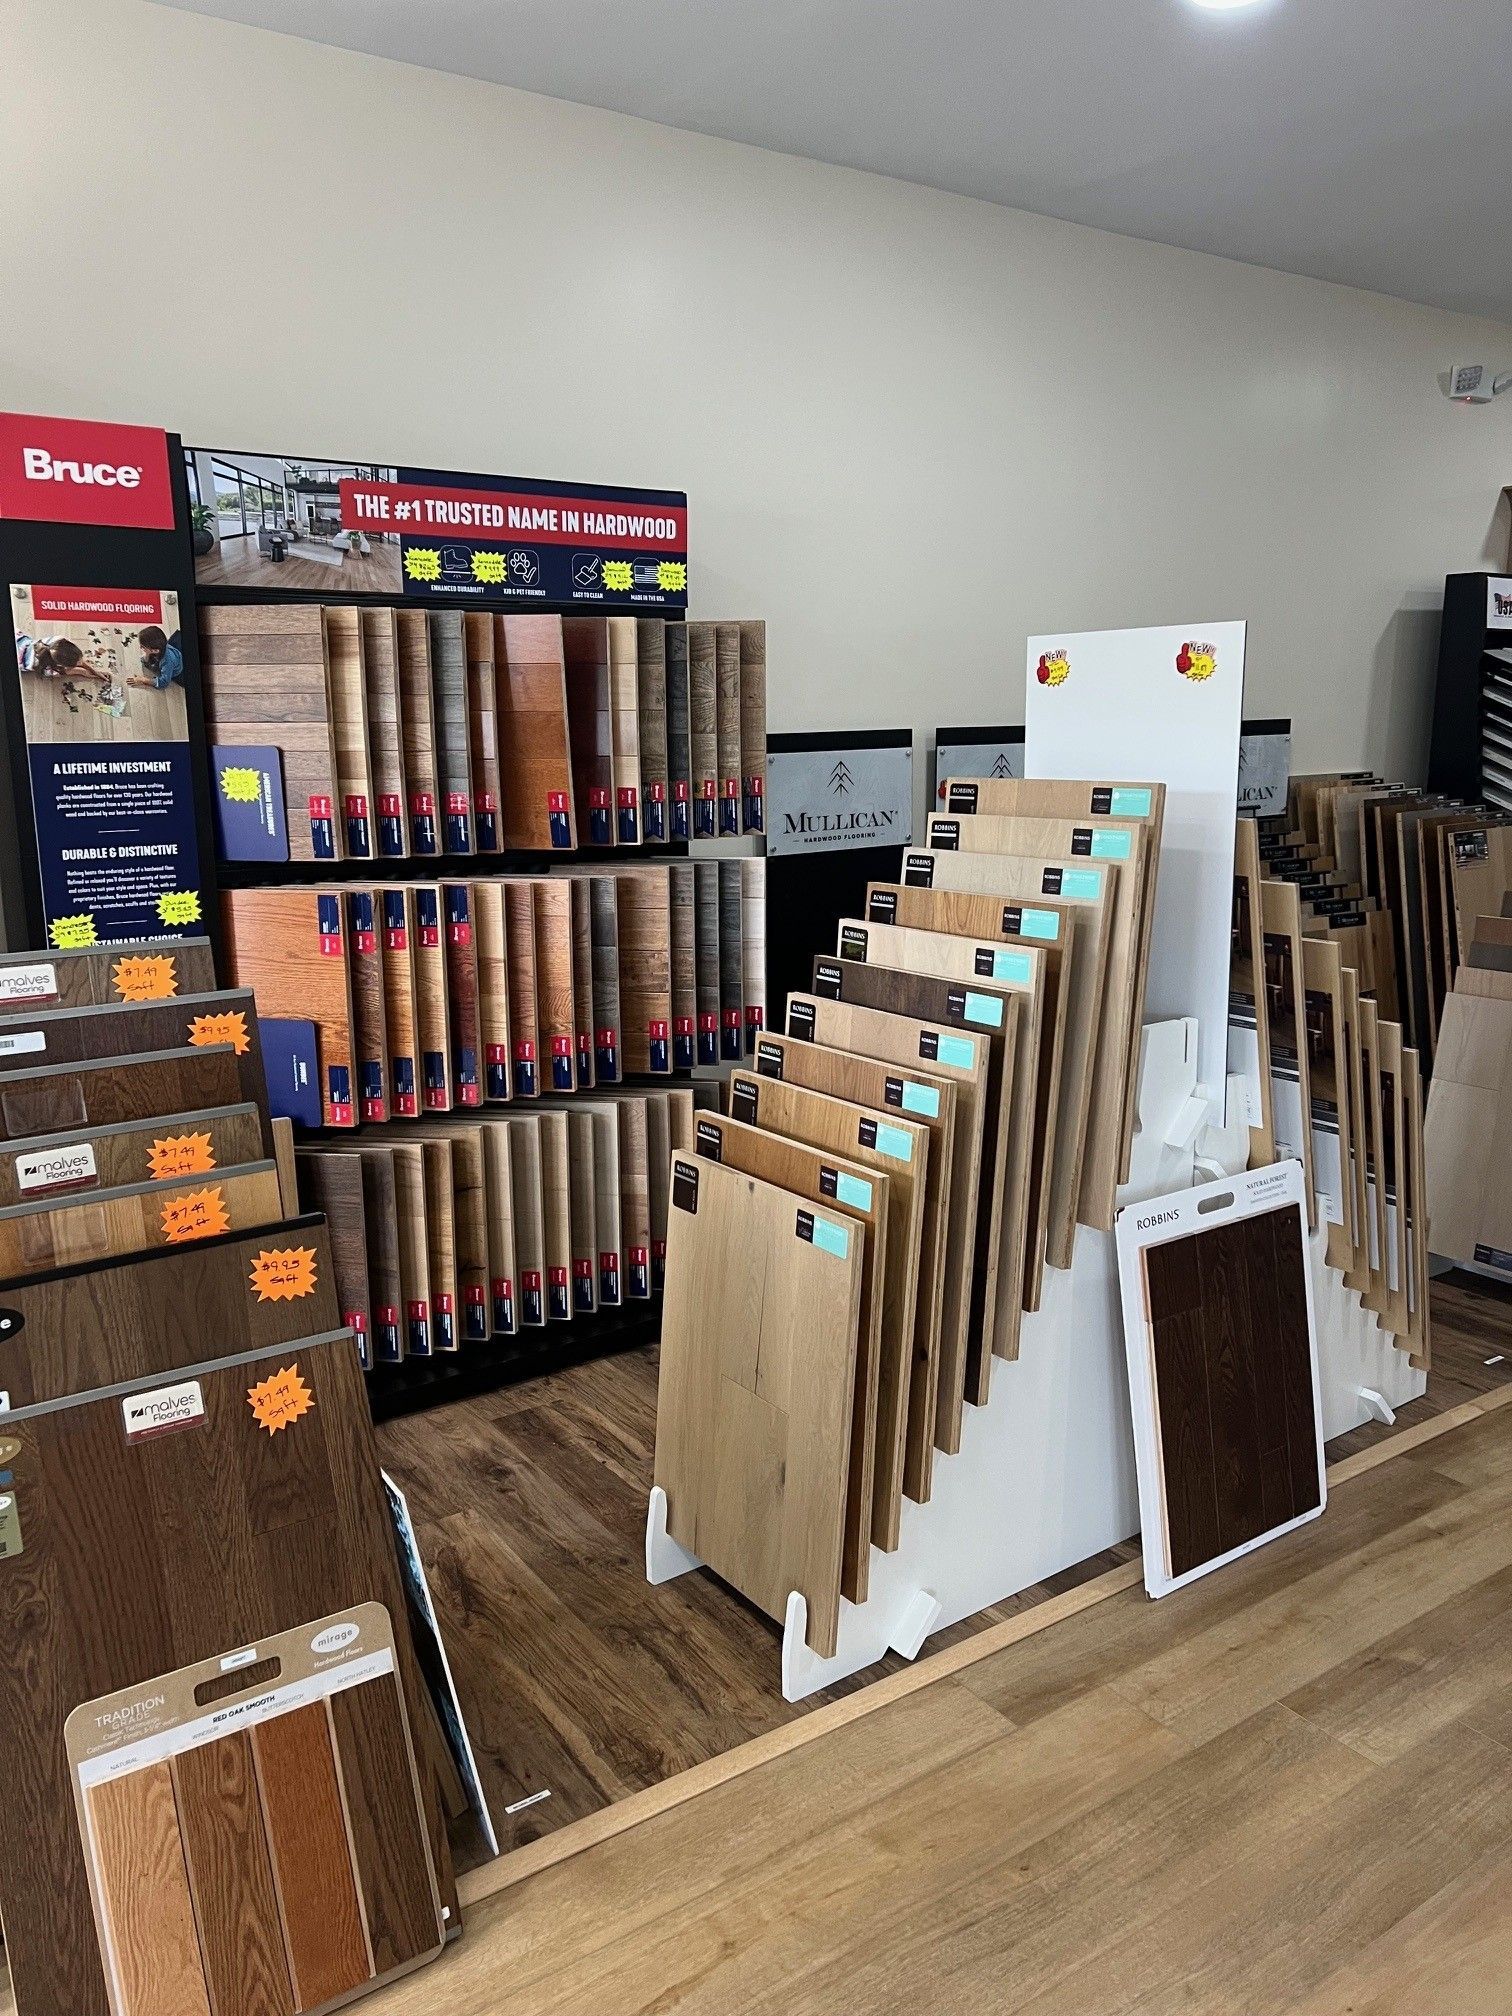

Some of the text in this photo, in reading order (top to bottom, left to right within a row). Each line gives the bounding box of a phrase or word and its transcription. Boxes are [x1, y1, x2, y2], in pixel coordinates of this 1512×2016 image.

[22, 447, 140, 487] Bruce
[353, 494, 676, 539] THE #1 TRUSTED NAME IN HARDWOOD
[431, 584, 456, 592] ENHANCED
[41, 600, 154, 614] SOLID HARDWOOD FLOORING
[54, 761, 171, 774] A LIFETIME INVESTMENT
[952, 787, 975, 795] ROBBINS
[783, 809, 894, 834] MULLICAN
[934, 824, 956, 832] ROBBINS
[804, 832, 876, 843] HARDWOOD FLOORING
[62, 844, 178, 860] DURABLE & DISTINCTIVE
[909, 858, 931, 866] ROBBINS
[873, 894, 895, 903] ROBBINS
[844, 930, 866, 940] ROBBINS
[123, 967, 157, 978] $7.49
[819, 967, 840, 977] ROBBINS
[2, 974, 50, 987] malves
[10, 985, 45, 994] Flooring
[792, 1004, 813, 1015] ROBBINS
[761, 1044, 781, 1056] ROBBINS
[735, 1082, 756, 1095] ROBBINS
[699, 1124, 720, 1138] ROBBINS
[38, 1156, 89, 1173] malves
[676, 1163, 697, 1178] ROBBINS
[46, 1168, 83, 1179] Flooring
[1136, 1209, 1180, 1230] ROBBINS
[262, 1260, 300, 1272] $9.95
[257, 1384, 290, 1407] $7.49
[144, 1394, 196, 1416] malves
[153, 1407, 191, 1422] Flooring
[318, 1628, 353, 1646] mirage
[314, 1651, 345, 1668] Hardwood
[94, 1694, 165, 1727] TRADITION
[213, 1695, 276, 1723] RED OAK SMOOTH
[112, 1709, 151, 1730] GRADE
[110, 1757, 138, 1770] NATURAL
